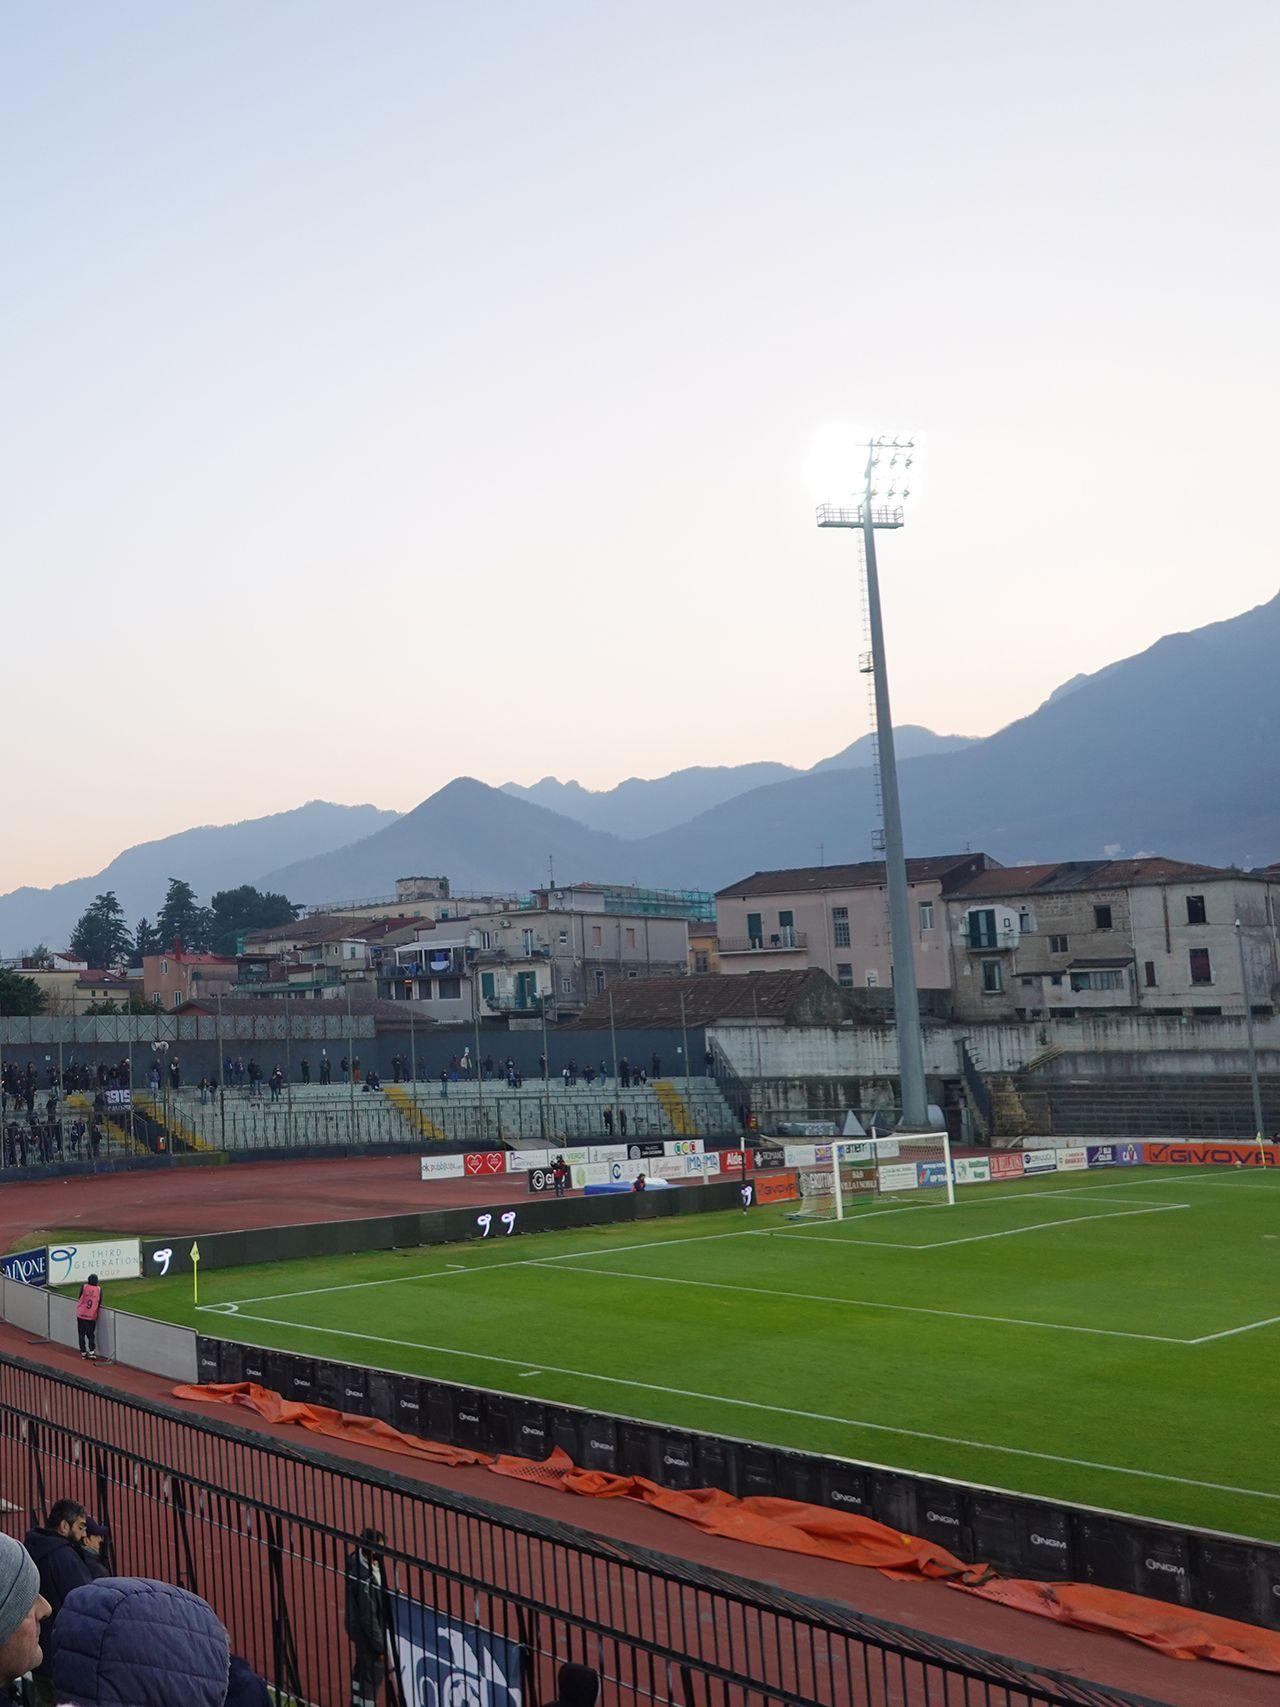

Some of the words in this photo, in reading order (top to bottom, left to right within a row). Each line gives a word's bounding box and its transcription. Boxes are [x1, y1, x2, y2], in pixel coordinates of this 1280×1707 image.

[1170, 1149, 1274, 1165] GIVOVA
[91, 1248, 121, 1258] THIRD
[74, 1256, 139, 1269] GENERATION
